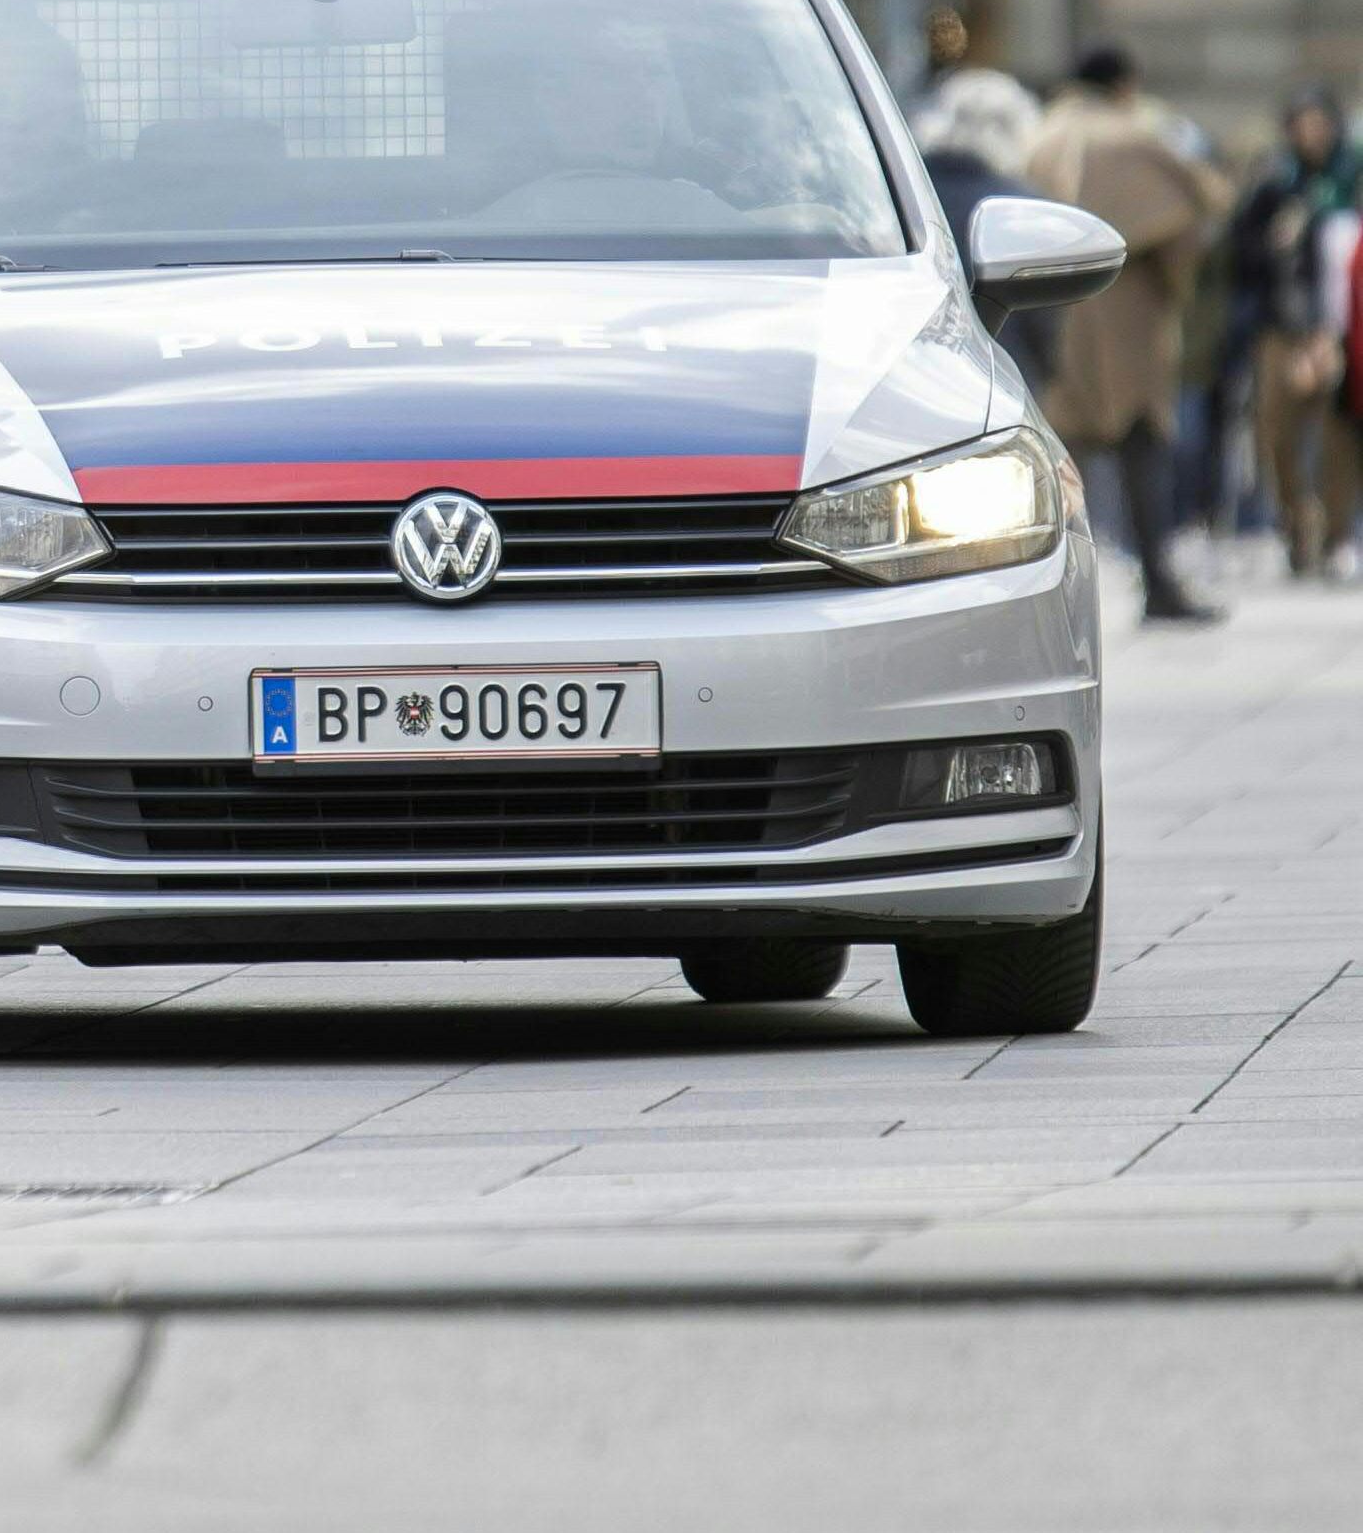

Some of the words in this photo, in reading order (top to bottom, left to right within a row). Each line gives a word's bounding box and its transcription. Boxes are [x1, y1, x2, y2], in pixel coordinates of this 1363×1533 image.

[157, 324, 667, 359] POLIZEI
[271, 726, 289, 744] A
[318, 686, 388, 743] BP
[439, 681, 627, 742] 90697
